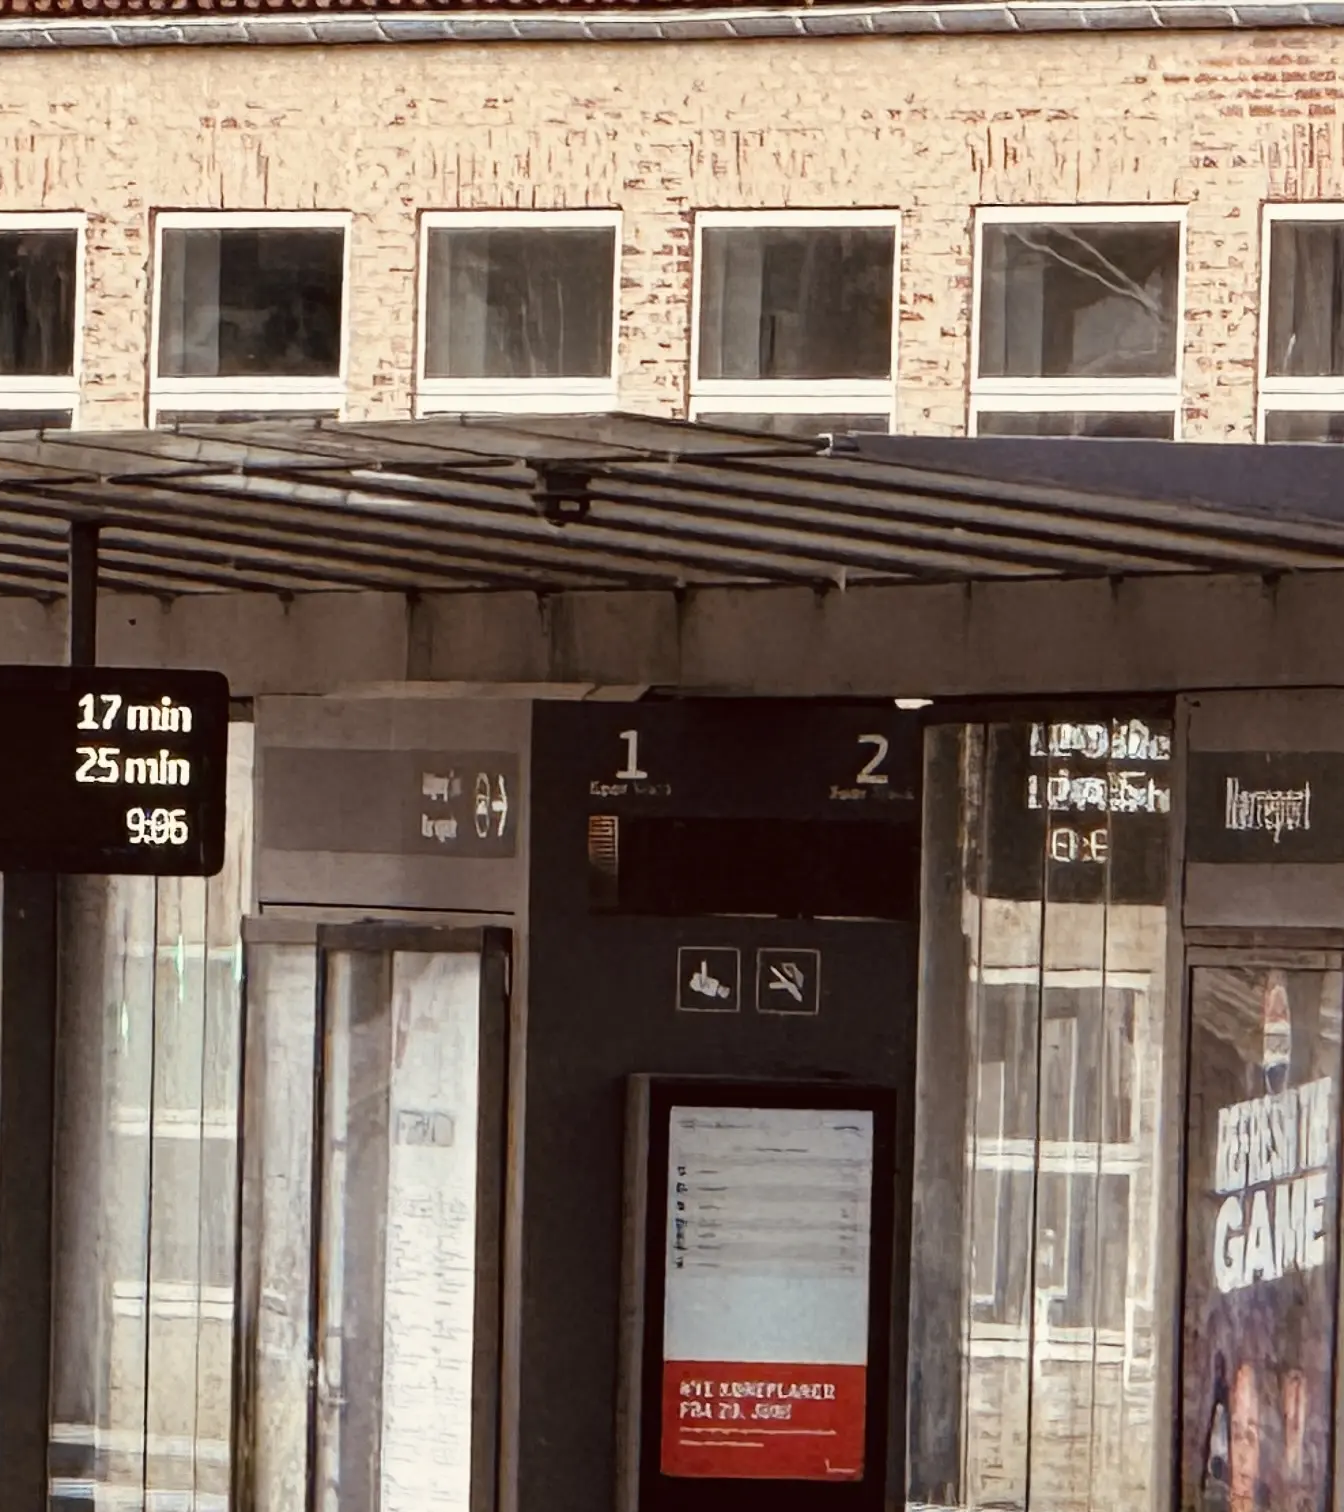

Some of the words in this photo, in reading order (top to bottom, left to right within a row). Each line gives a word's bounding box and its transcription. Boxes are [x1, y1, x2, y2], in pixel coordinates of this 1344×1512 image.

[76, 692, 123, 731] 17
[126, 695, 193, 733] min
[75, 746, 121, 783] 25
[124, 748, 191, 787] min
[615, 729, 649, 780] 1
[855, 733, 890, 785] 2
[1213, 1171, 1329, 1294] GAME
